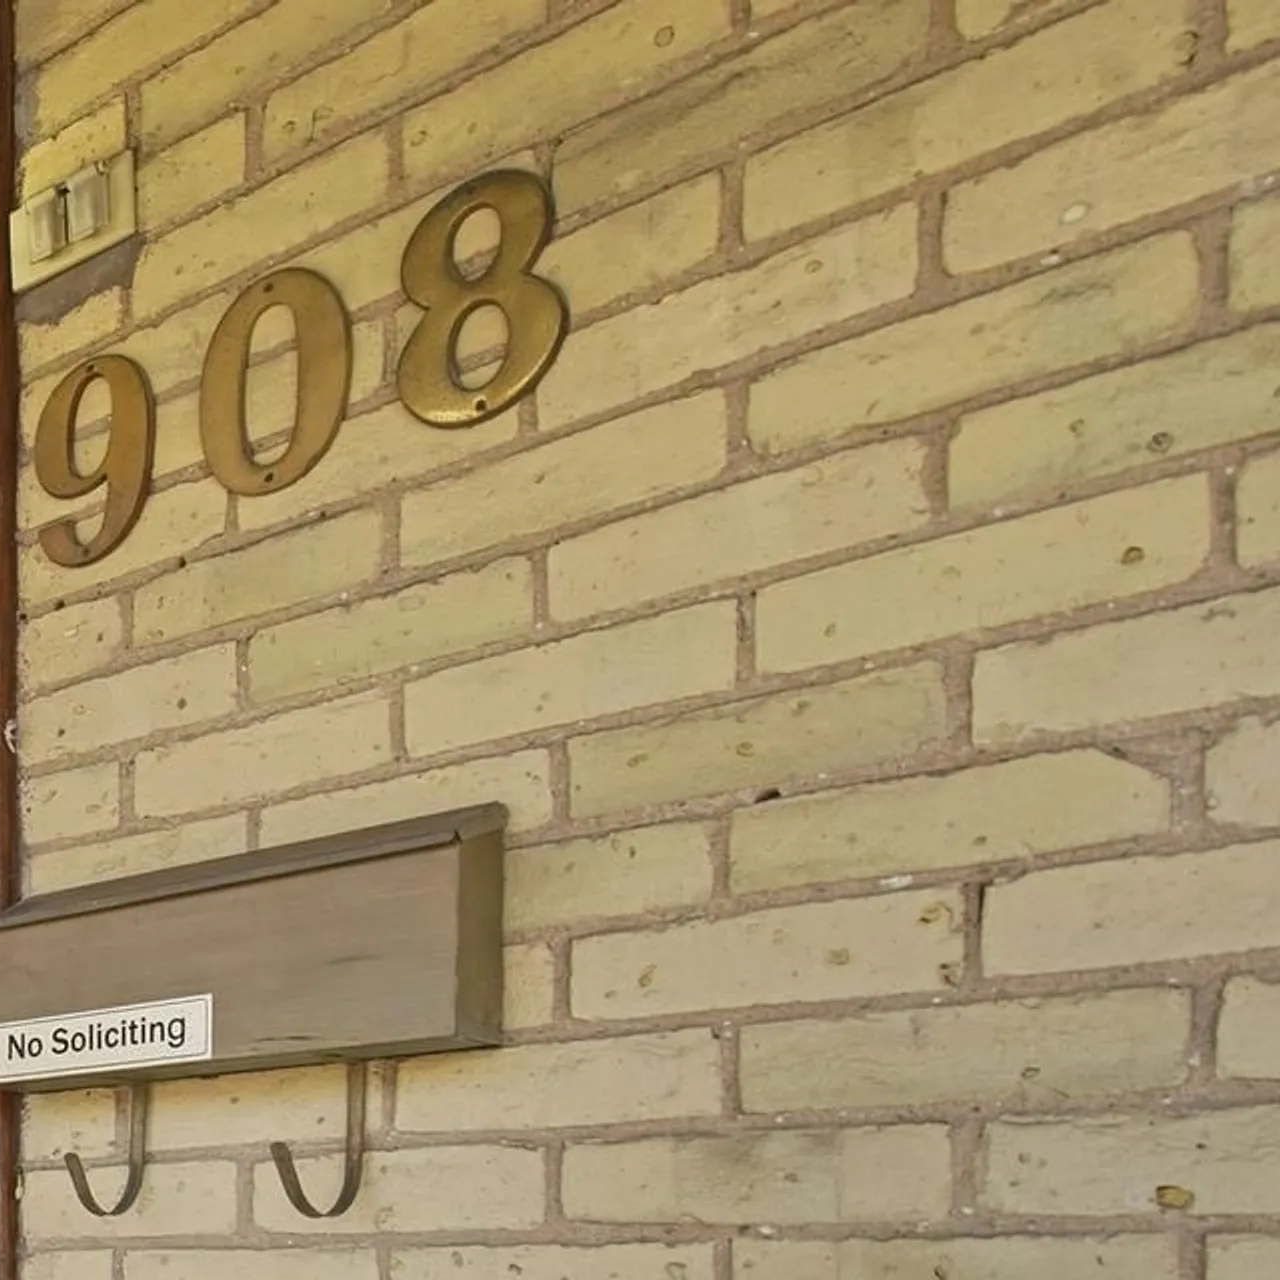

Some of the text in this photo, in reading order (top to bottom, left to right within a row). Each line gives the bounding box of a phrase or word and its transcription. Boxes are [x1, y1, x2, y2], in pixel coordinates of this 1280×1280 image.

[34, 168, 570, 568] 908
[7, 1016, 186, 1061] No Soliciting
